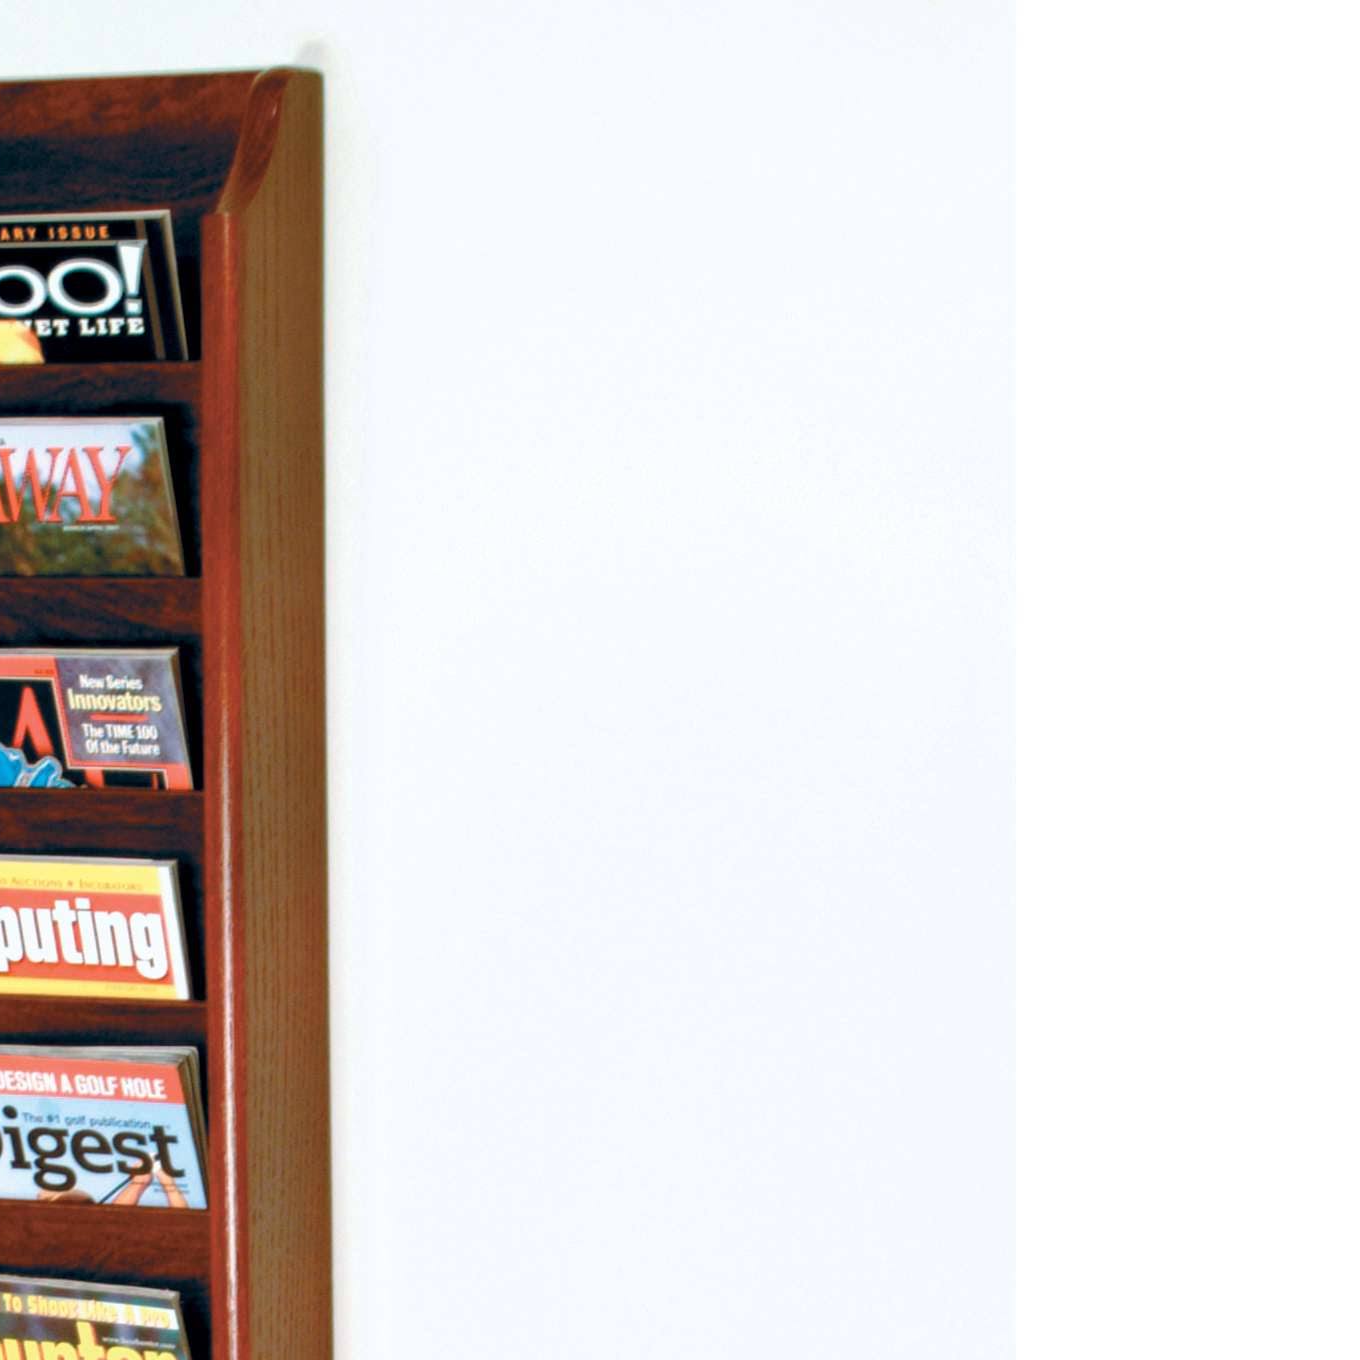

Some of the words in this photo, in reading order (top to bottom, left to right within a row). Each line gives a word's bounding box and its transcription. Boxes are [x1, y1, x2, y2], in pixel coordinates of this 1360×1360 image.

[48, 224, 110, 240] ISSUE
[79, 317, 145, 337] LIFE
[78, 673, 103, 688] New
[106, 674, 144, 690] Series
[67, 687, 163, 712] Innovators
[82, 723, 105, 738] The
[105, 724, 134, 739] TIME
[136, 725, 158, 740] 100
[86, 739, 98, 755] Of
[100, 740, 120, 755] the
[122, 740, 161, 756] Future
[60, 1073, 73, 1094] A
[75, 1074, 119, 1097] GOLF
[121, 1077, 167, 1100] HOLE
[21, 1112, 44, 1124] The
[64, 1114, 86, 1128] golf
[90, 1115, 151, 1131] publication
[3, 1293, 23, 1314] To
